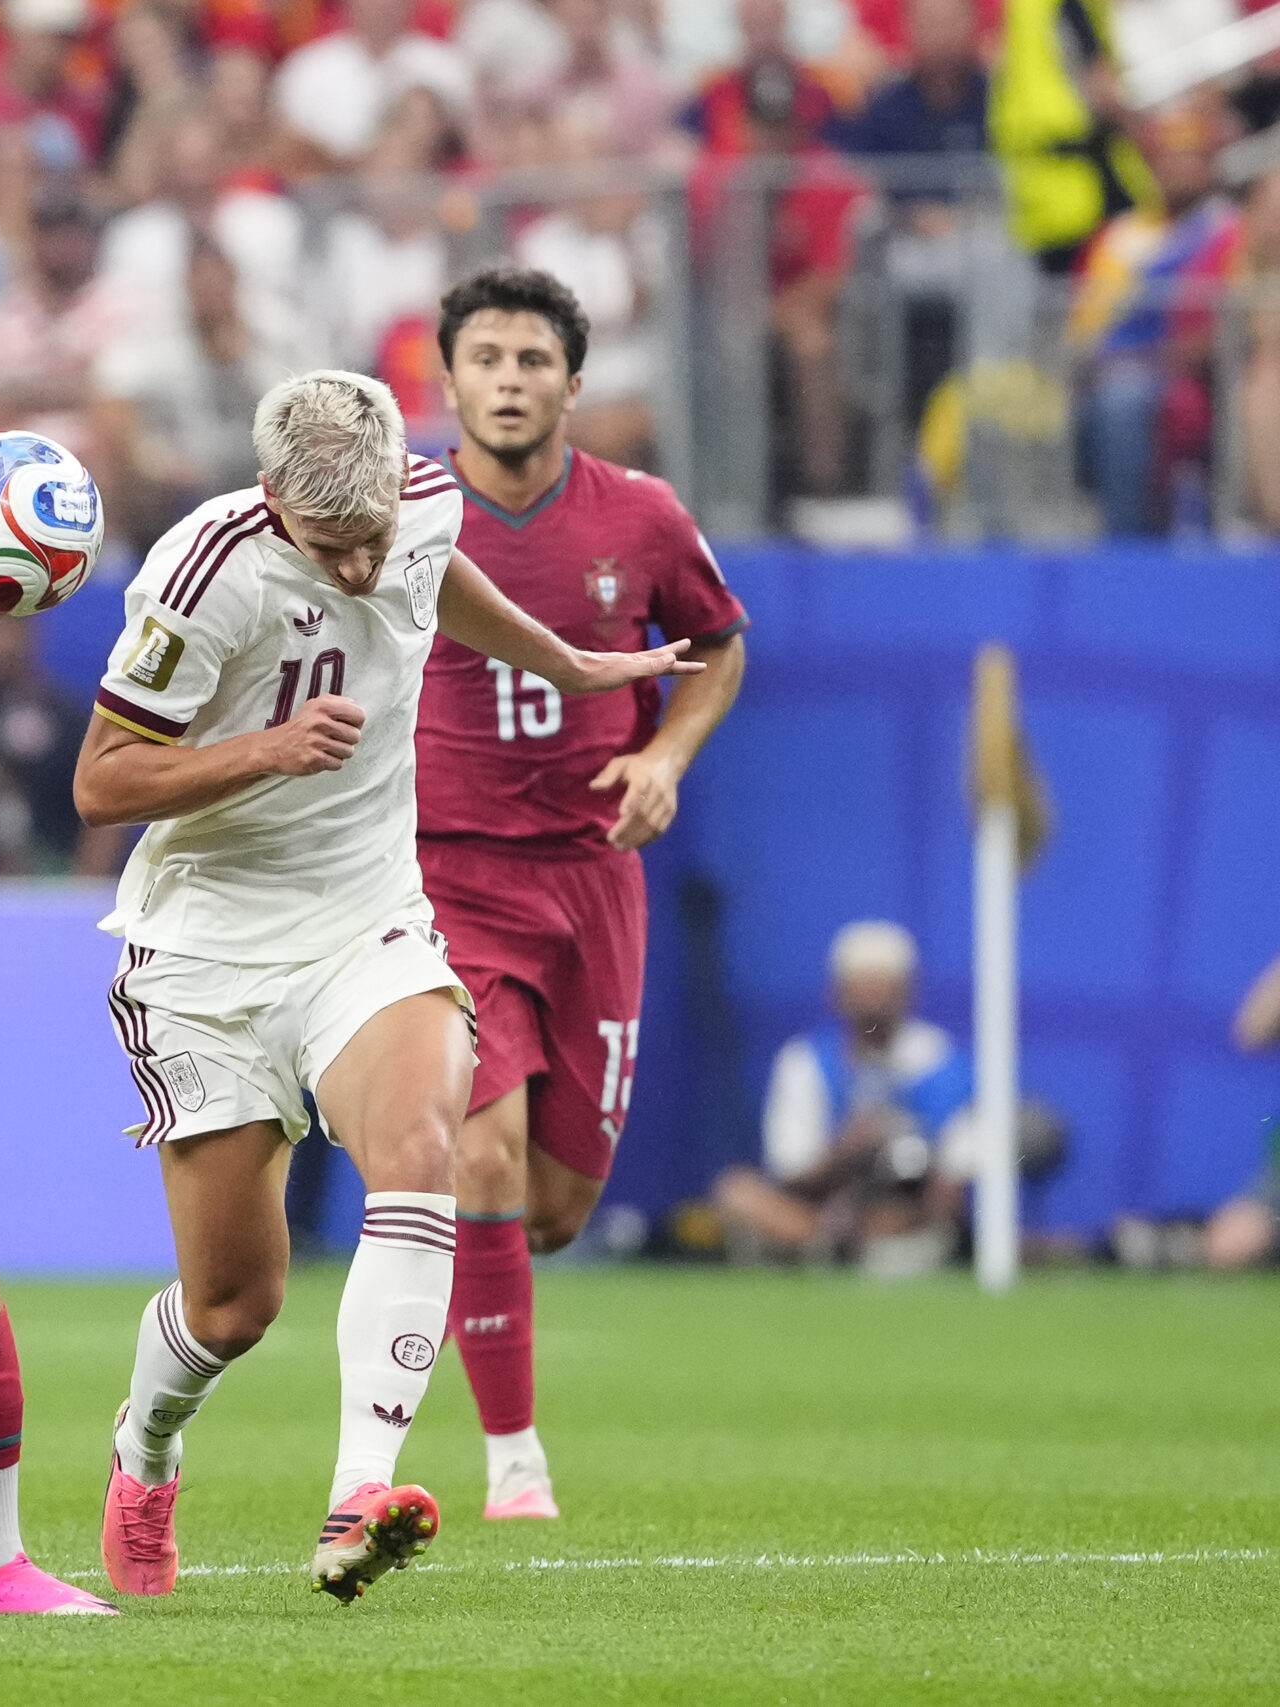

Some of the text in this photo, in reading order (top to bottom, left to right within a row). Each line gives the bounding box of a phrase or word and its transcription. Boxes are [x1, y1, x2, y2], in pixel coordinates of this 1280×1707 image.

[264, 647, 345, 731] 10
[404, 1340, 428, 1352] RF
[402, 1351, 425, 1363] EF
